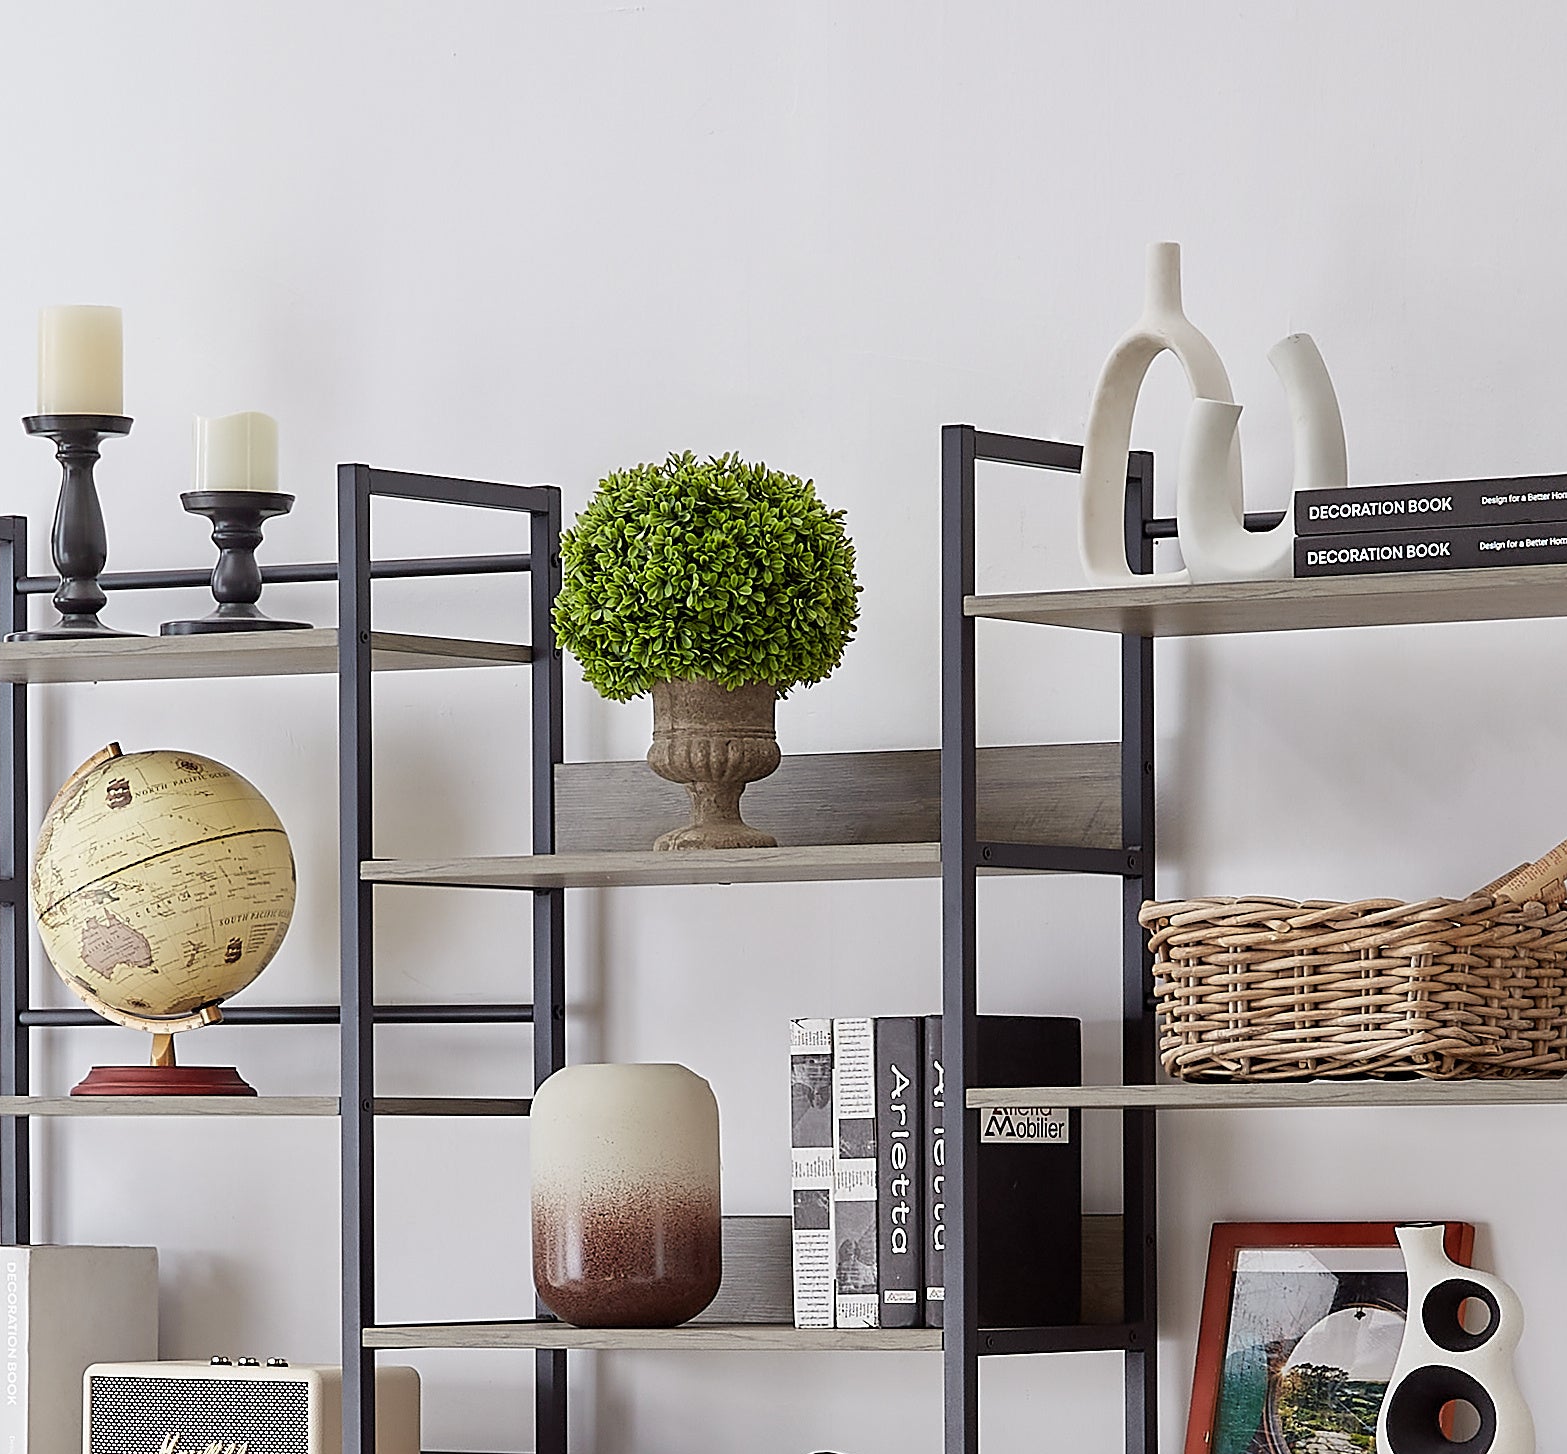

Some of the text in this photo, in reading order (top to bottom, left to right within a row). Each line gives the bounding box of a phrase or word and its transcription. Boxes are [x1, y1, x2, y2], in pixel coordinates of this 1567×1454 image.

[1308, 497, 1453, 520] DECORATION BOOK
[1481, 495, 1508, 506] Design
[1508, 494, 1520, 503] for
[1527, 492, 1550, 502] Better
[1307, 542, 1451, 566] DECORATION BOOK
[1479, 540, 1506, 551] Design
[1506, 540, 1518, 549] for
[1525, 537, 1549, 547] Better
[135, 784, 168, 798] NORTH
[172, 775, 207, 787] PACIFIC
[219, 915, 248, 927] SOUTH
[250, 910, 277, 921] PACIFIC
[984, 1115, 1065, 1138] Mobilier
[890, 1064, 910, 1254] Arletta
[6, 1262, 17, 1405] DECORATION BOOK
